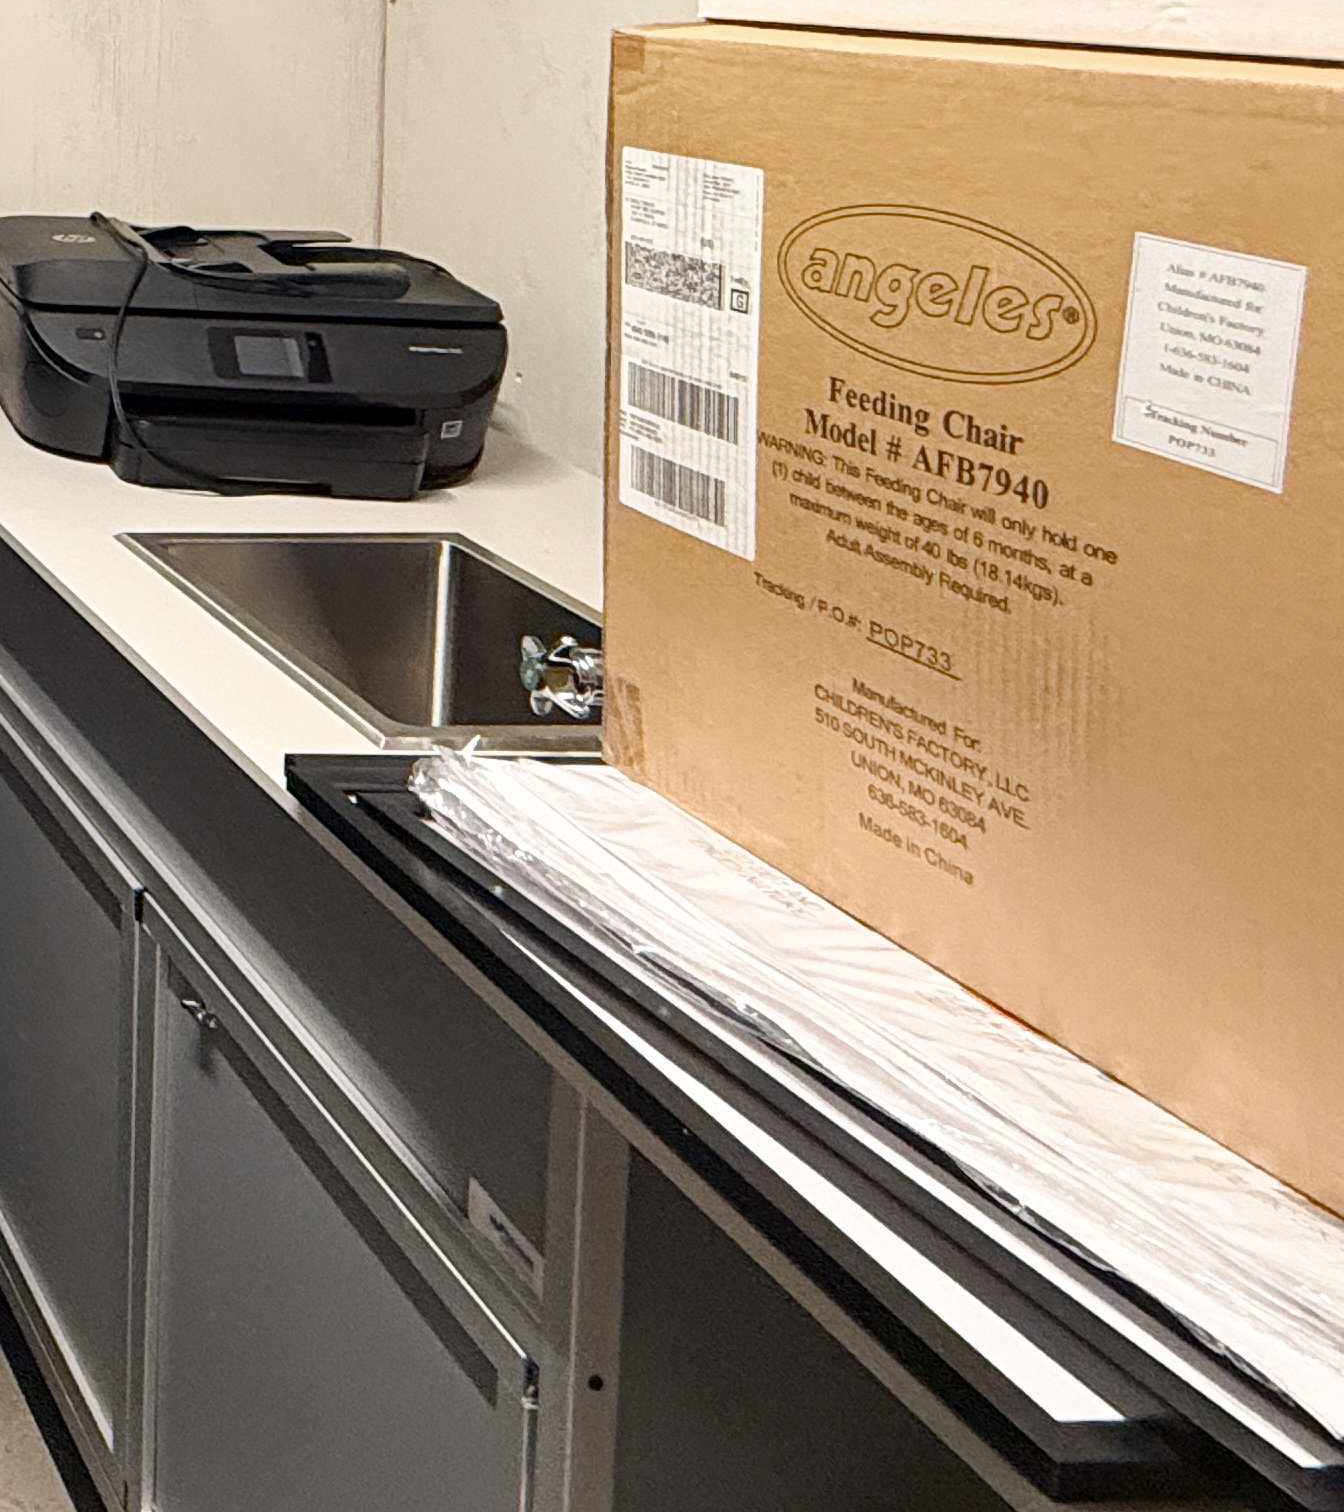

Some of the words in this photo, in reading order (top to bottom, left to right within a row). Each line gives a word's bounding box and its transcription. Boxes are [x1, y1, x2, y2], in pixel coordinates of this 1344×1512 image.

[1157, 301, 1215, 324] Children's
[1218, 315, 1264, 337] Factory
[1165, 283, 1241, 309] Manufactured
[1245, 301, 1264, 314] for
[1208, 272, 1266, 292] AFB7940
[1199, 332, 1222, 345] MO
[827, 376, 930, 437] Feeding
[942, 410, 1024, 455] Chair
[1160, 363, 1190, 381] Made
[1207, 375, 1252, 396] CHINA
[805, 408, 877, 456] Model
[886, 435, 903, 462] #
[912, 446, 1050, 510] AFB7940
[1148, 408, 1197, 434] Tracking
[1201, 425, 1248, 447] Number
[771, 460, 789, 482] (1)
[792, 466, 821, 490] child
[825, 474, 882, 509] between
[886, 498, 909, 521] the
[912, 513, 949, 537] ages
[953, 523, 970, 542] of
[972, 530, 983, 548] 6
[987, 536, 1052, 575] months,
[1059, 561, 1077, 580] at
[1081, 572, 1094, 587] a
[789, 492, 851, 526] maximum
[855, 515, 902, 547] weight
[905, 534, 920, 551] of
[922, 539, 941, 559] 40
[946, 547, 968, 570] lbs
[832, 455, 861, 478] This
[865, 465, 921, 503] Feeding
[927, 488, 968, 514] Chair
[971, 505, 996, 524] will
[1002, 515, 1036, 541] only
[1041, 528, 1077, 553] hold
[1082, 542, 1118, 565] one
[825, 528, 862, 557] Adult
[865, 542, 934, 587] Assembly
[939, 570, 1012, 614] Required.
[754, 571, 806, 610] Tracking
[868, 620, 953, 672] POP733
[814, 683, 904, 741] CHILDREN'S
[994, 771, 1031, 803] LLC
[852, 678, 947, 737] Manufactured
[814, 706, 841, 732] 510
[842, 722, 897, 759] SOUTH
[900, 749, 986, 805] MCKINLEY
[908, 780, 936, 806] MO
[938, 793, 987, 834] 63084
[859, 811, 903, 849] Made
[906, 836, 921, 856] in
[924, 846, 974, 886] China
